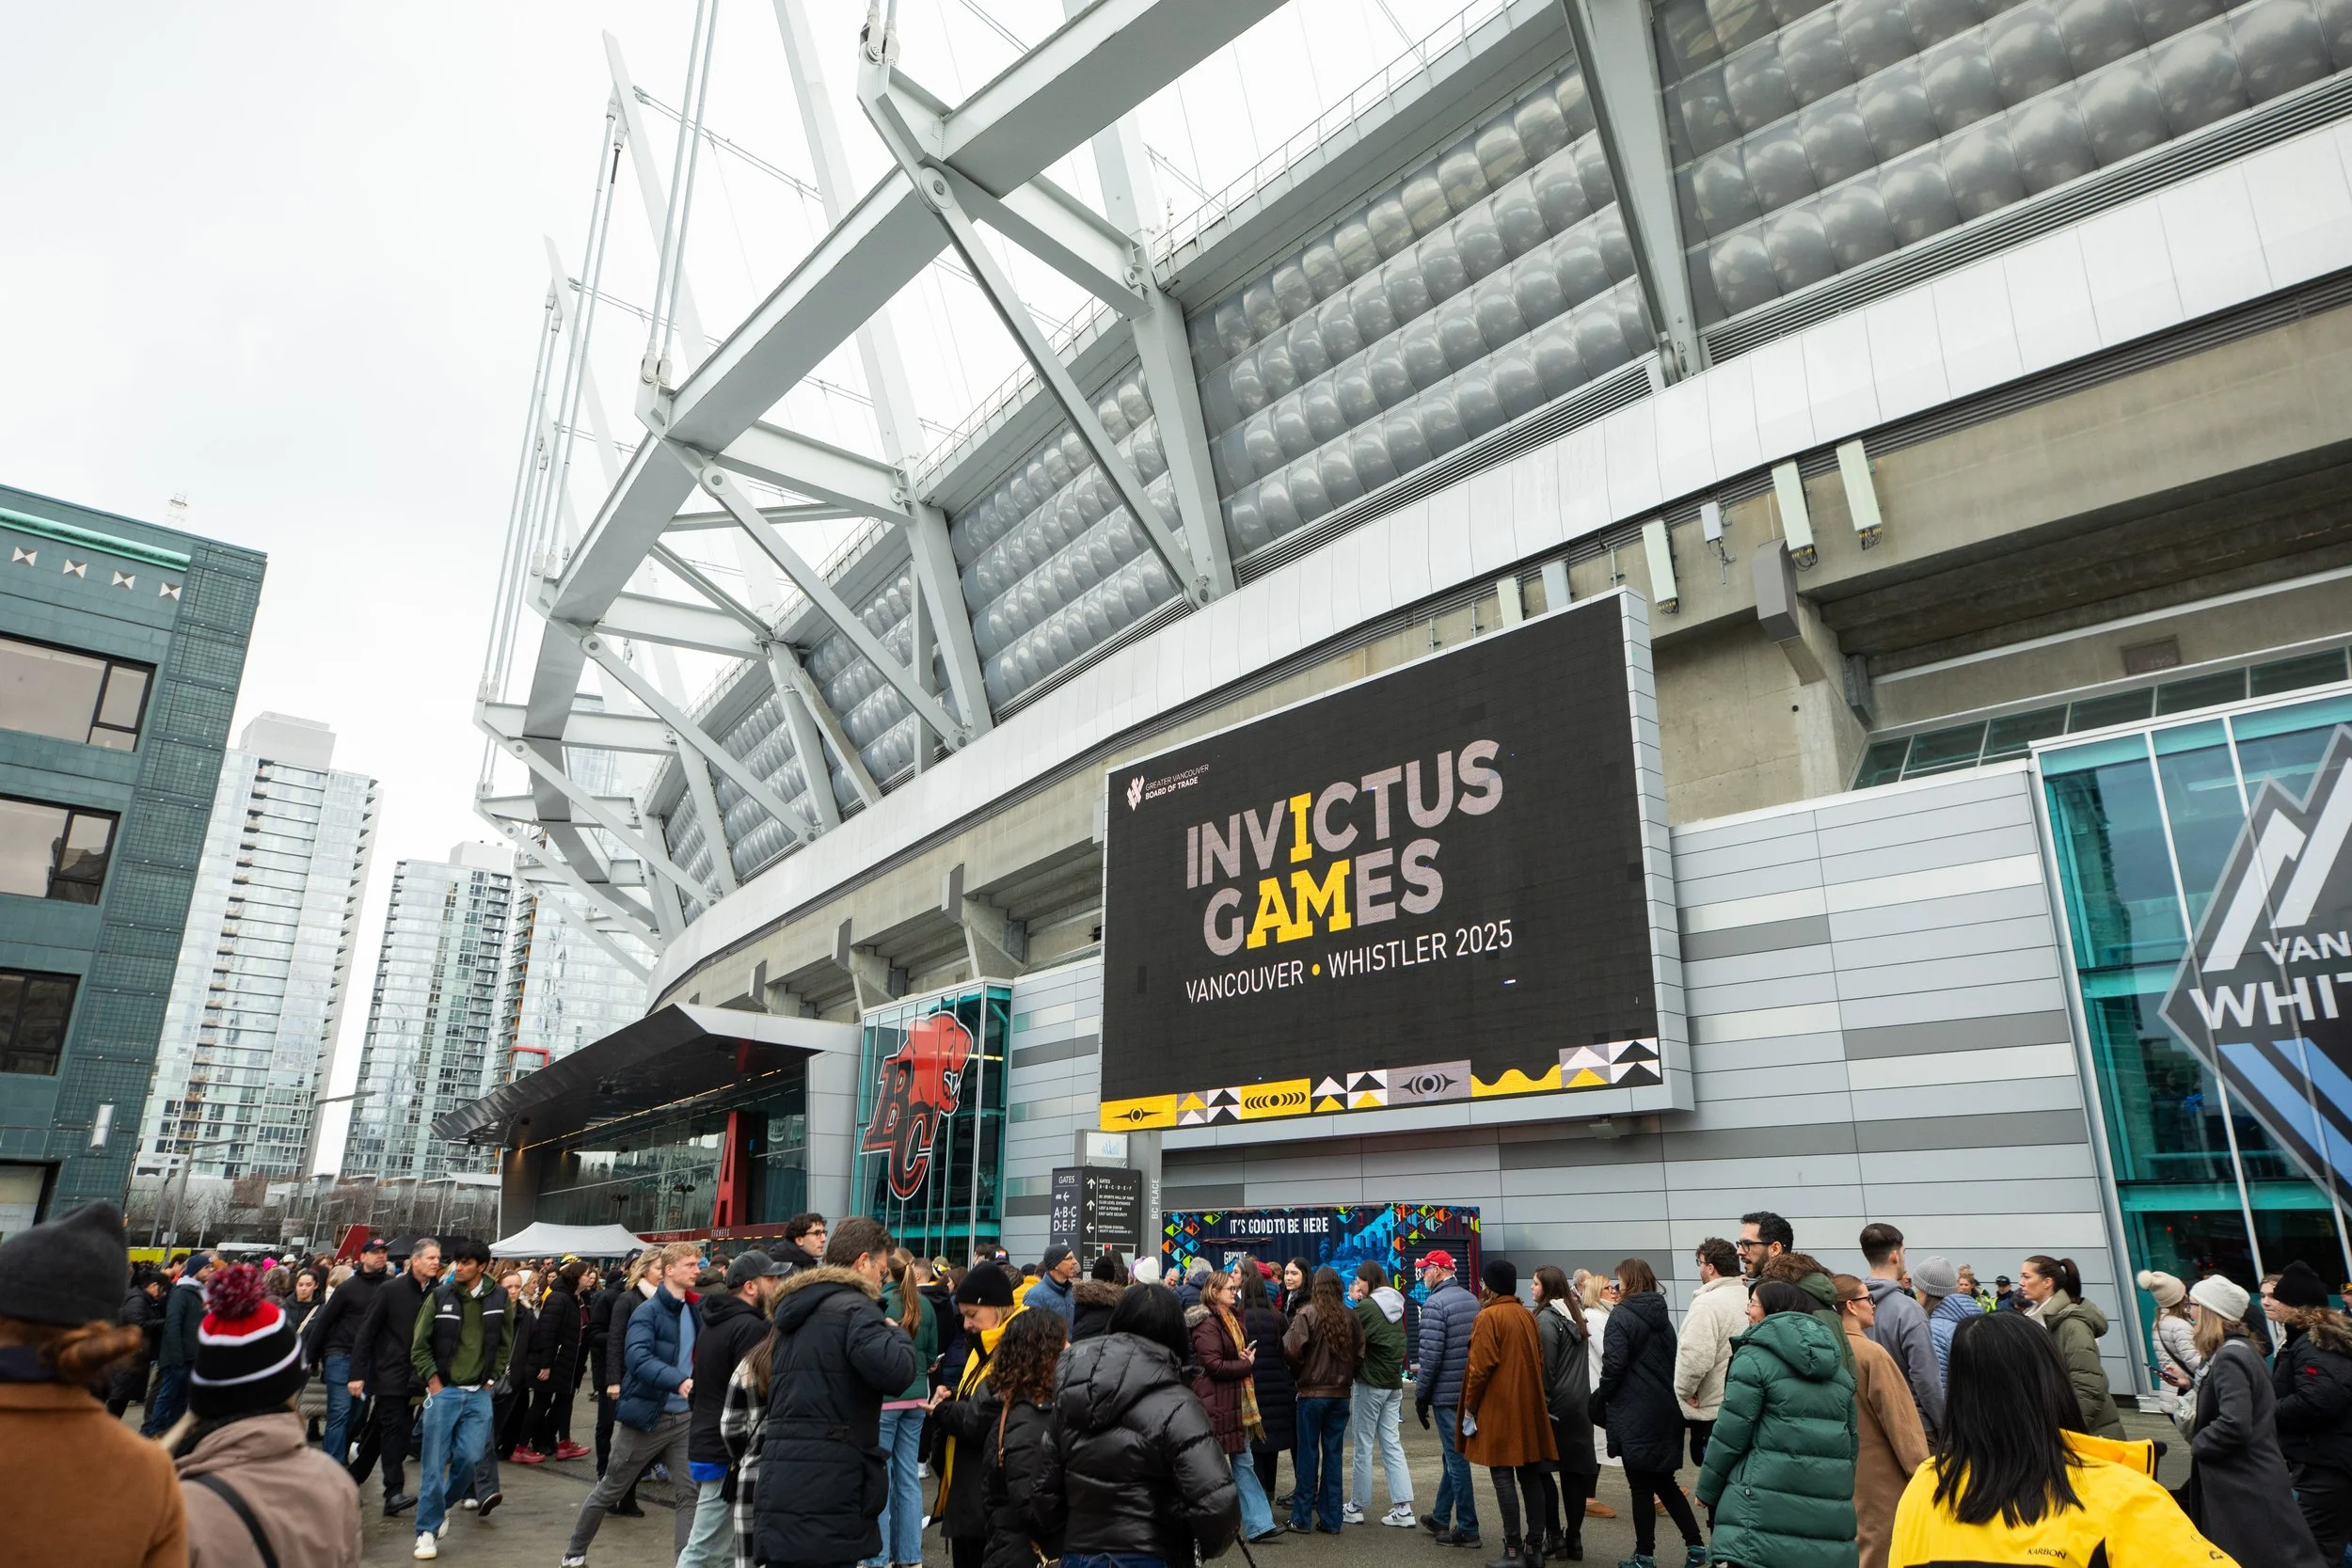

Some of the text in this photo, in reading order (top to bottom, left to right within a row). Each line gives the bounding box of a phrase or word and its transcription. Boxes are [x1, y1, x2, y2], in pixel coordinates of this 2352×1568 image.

[1145, 764, 1209, 791] GREATER VANCOUVER
[1145, 776, 1199, 800] BOARD OF TRADE
[1187, 739, 1503, 890] INVICTUS
[1203, 838, 1444, 957] GAMES
[2261, 931, 2352, 965] VAN
[1185, 919, 1513, 1004] VANCOUVER WHISTLER 2025
[1058, 1175, 1075, 1184] GATES
[1152, 1207, 1159, 1220] BC
[1230, 1219, 1246, 1234] IT'S
[1288, 1218, 1300, 1234] BE
[1303, 1216, 1329, 1233] HERE
[711, 1228, 730, 1237] TICKETS
[2027, 1547, 2067, 1560] KARBON
